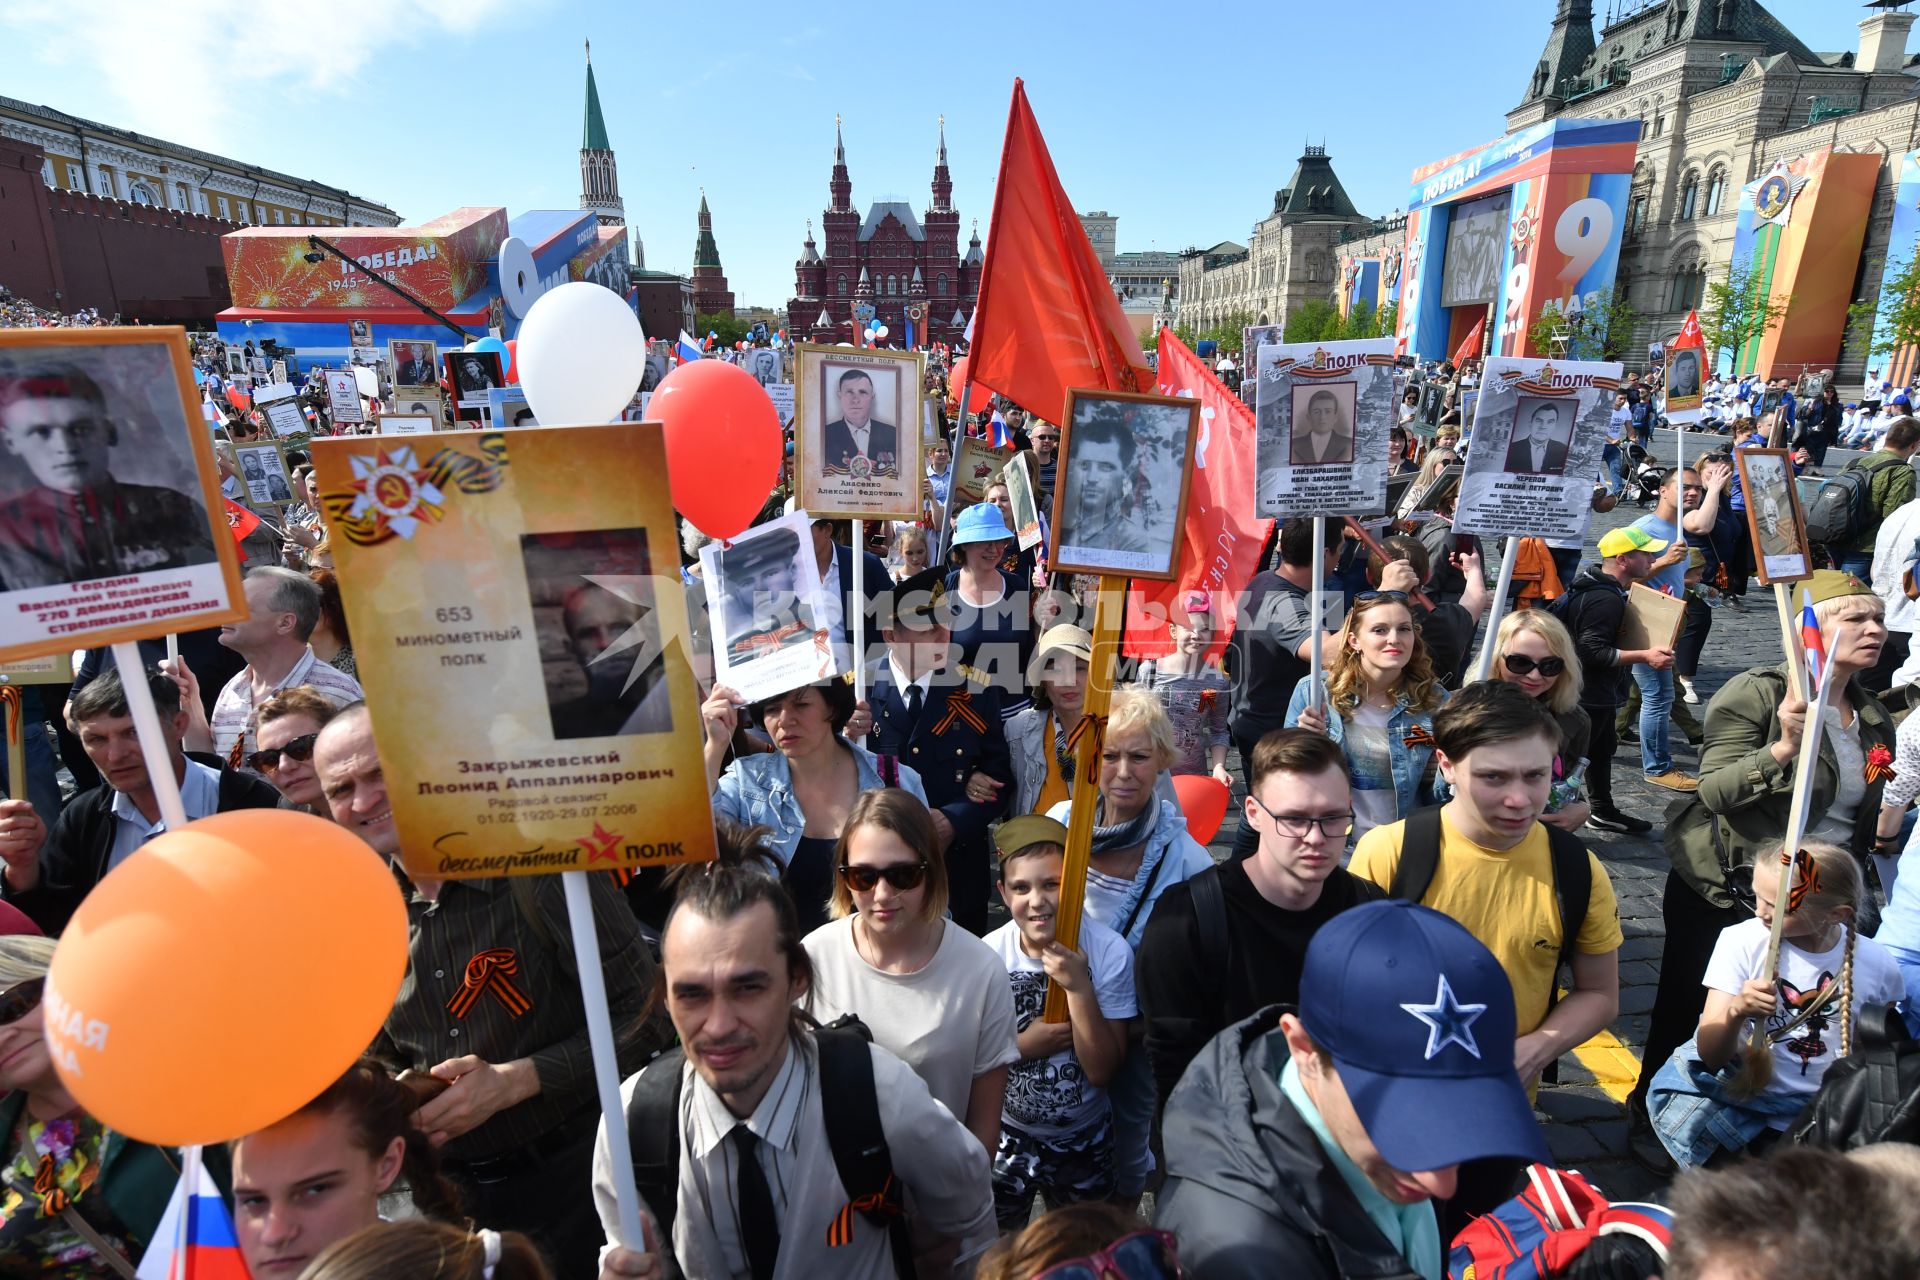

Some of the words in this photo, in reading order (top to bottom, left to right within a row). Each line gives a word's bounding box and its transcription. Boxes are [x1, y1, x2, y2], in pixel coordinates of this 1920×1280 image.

[1422, 160, 1482, 203] ПОБЕДА!
[1554, 198, 1613, 287] 9
[341, 244, 438, 274] ПОБЕДА!
[1506, 263, 1530, 321] 9
[1499, 317, 1525, 337] МАЯ
[1326, 353, 1367, 370] ПОЛК
[1552, 374, 1594, 388] ПОЛК
[1292, 467, 1352, 475] ЕЛИЗБАРАШВИЛИ
[1515, 475, 1547, 483] ЧЕРЕПОВ
[817, 488, 854, 496] Алексей
[858, 489, 903, 497] Федотович
[1494, 482, 1526, 490] ВАСИЛИЙ
[72, 576, 140, 592] Гордин
[18, 592, 103, 613] Василий
[107, 580, 193, 600] Иванович
[37, 610, 70, 623] 270
[48, 611, 148, 634] стрелковая
[151, 598, 219, 620] дивизия
[436, 606, 473, 623] 653
[396, 626, 522, 647] минометный
[440, 652, 488, 667] полк
[458, 751, 621, 774] Закрыжевский
[418, 780, 500, 798] Леонид
[506, 766, 675, 791] Аппалинарович
[488, 793, 549, 810] Рядовой
[553, 791, 608, 806] связист
[477, 804, 638, 825] 01.02.1920-29.07.2006
[625, 842, 685, 860] ПОЛК
